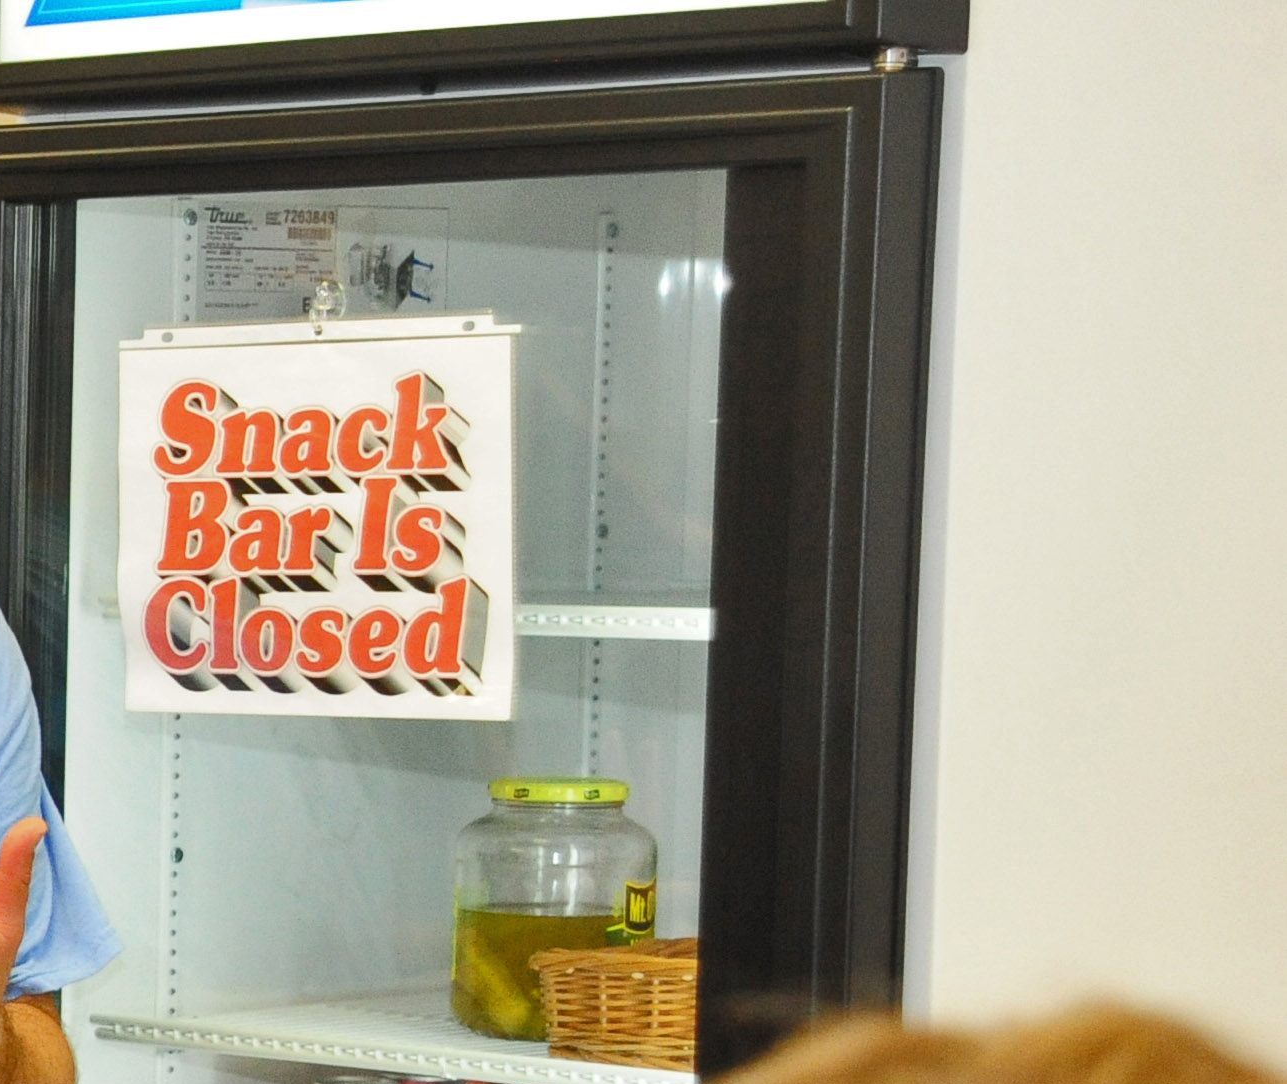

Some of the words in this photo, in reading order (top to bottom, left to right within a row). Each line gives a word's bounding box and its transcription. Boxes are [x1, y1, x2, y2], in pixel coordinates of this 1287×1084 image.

[153, 371, 451, 476] Snack
[156, 478, 333, 574] Bar
[352, 477, 445, 574] Is
[143, 574, 471, 677] Closed
